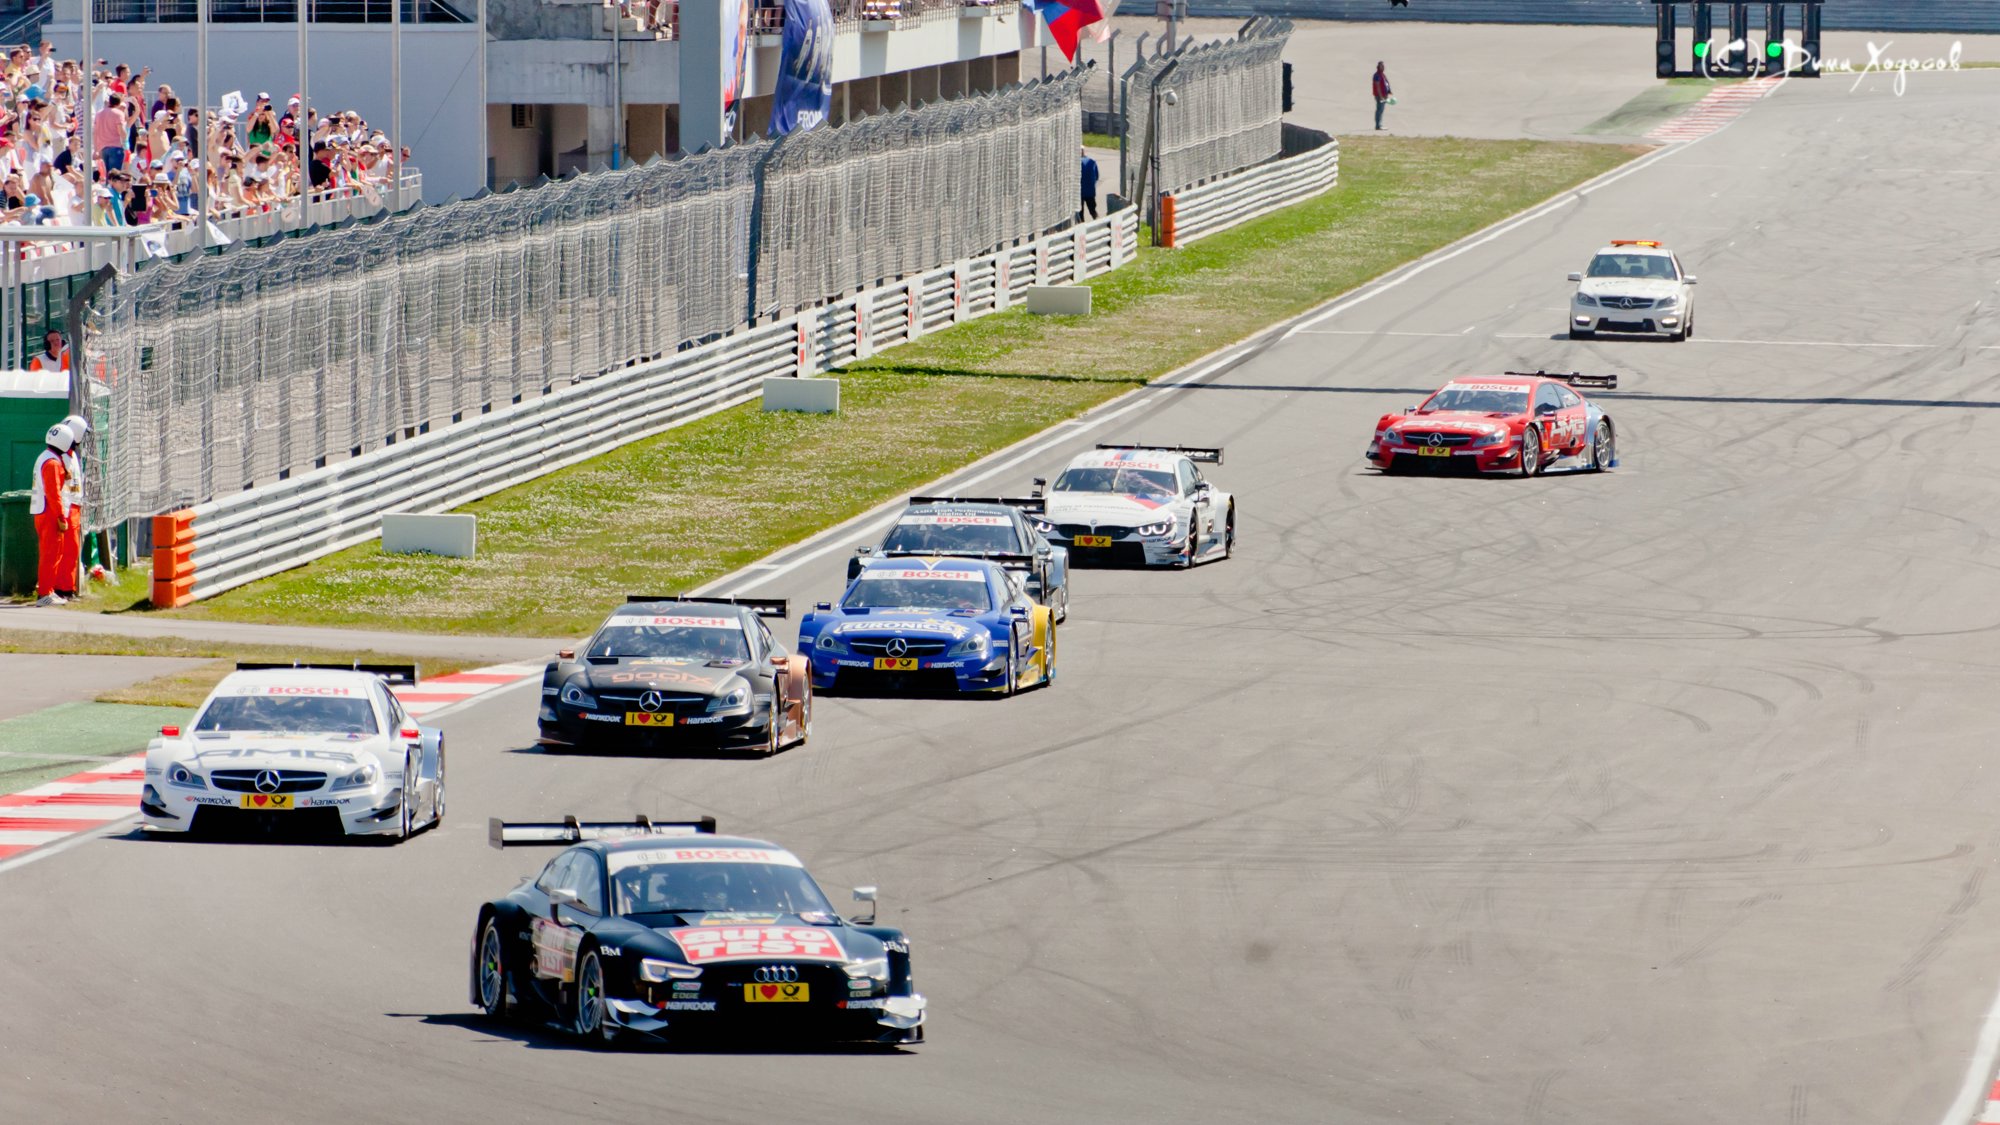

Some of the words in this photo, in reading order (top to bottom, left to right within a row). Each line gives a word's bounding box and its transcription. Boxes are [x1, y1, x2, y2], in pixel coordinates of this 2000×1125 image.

[1104, 461, 1160, 469] BOSCH
[902, 571, 969, 579] BOSCH
[654, 618, 725, 626] BOSCH
[268, 687, 349, 696] BOSCH
[676, 850, 770, 861] BOSCH
[687, 941, 831, 957] TEST
